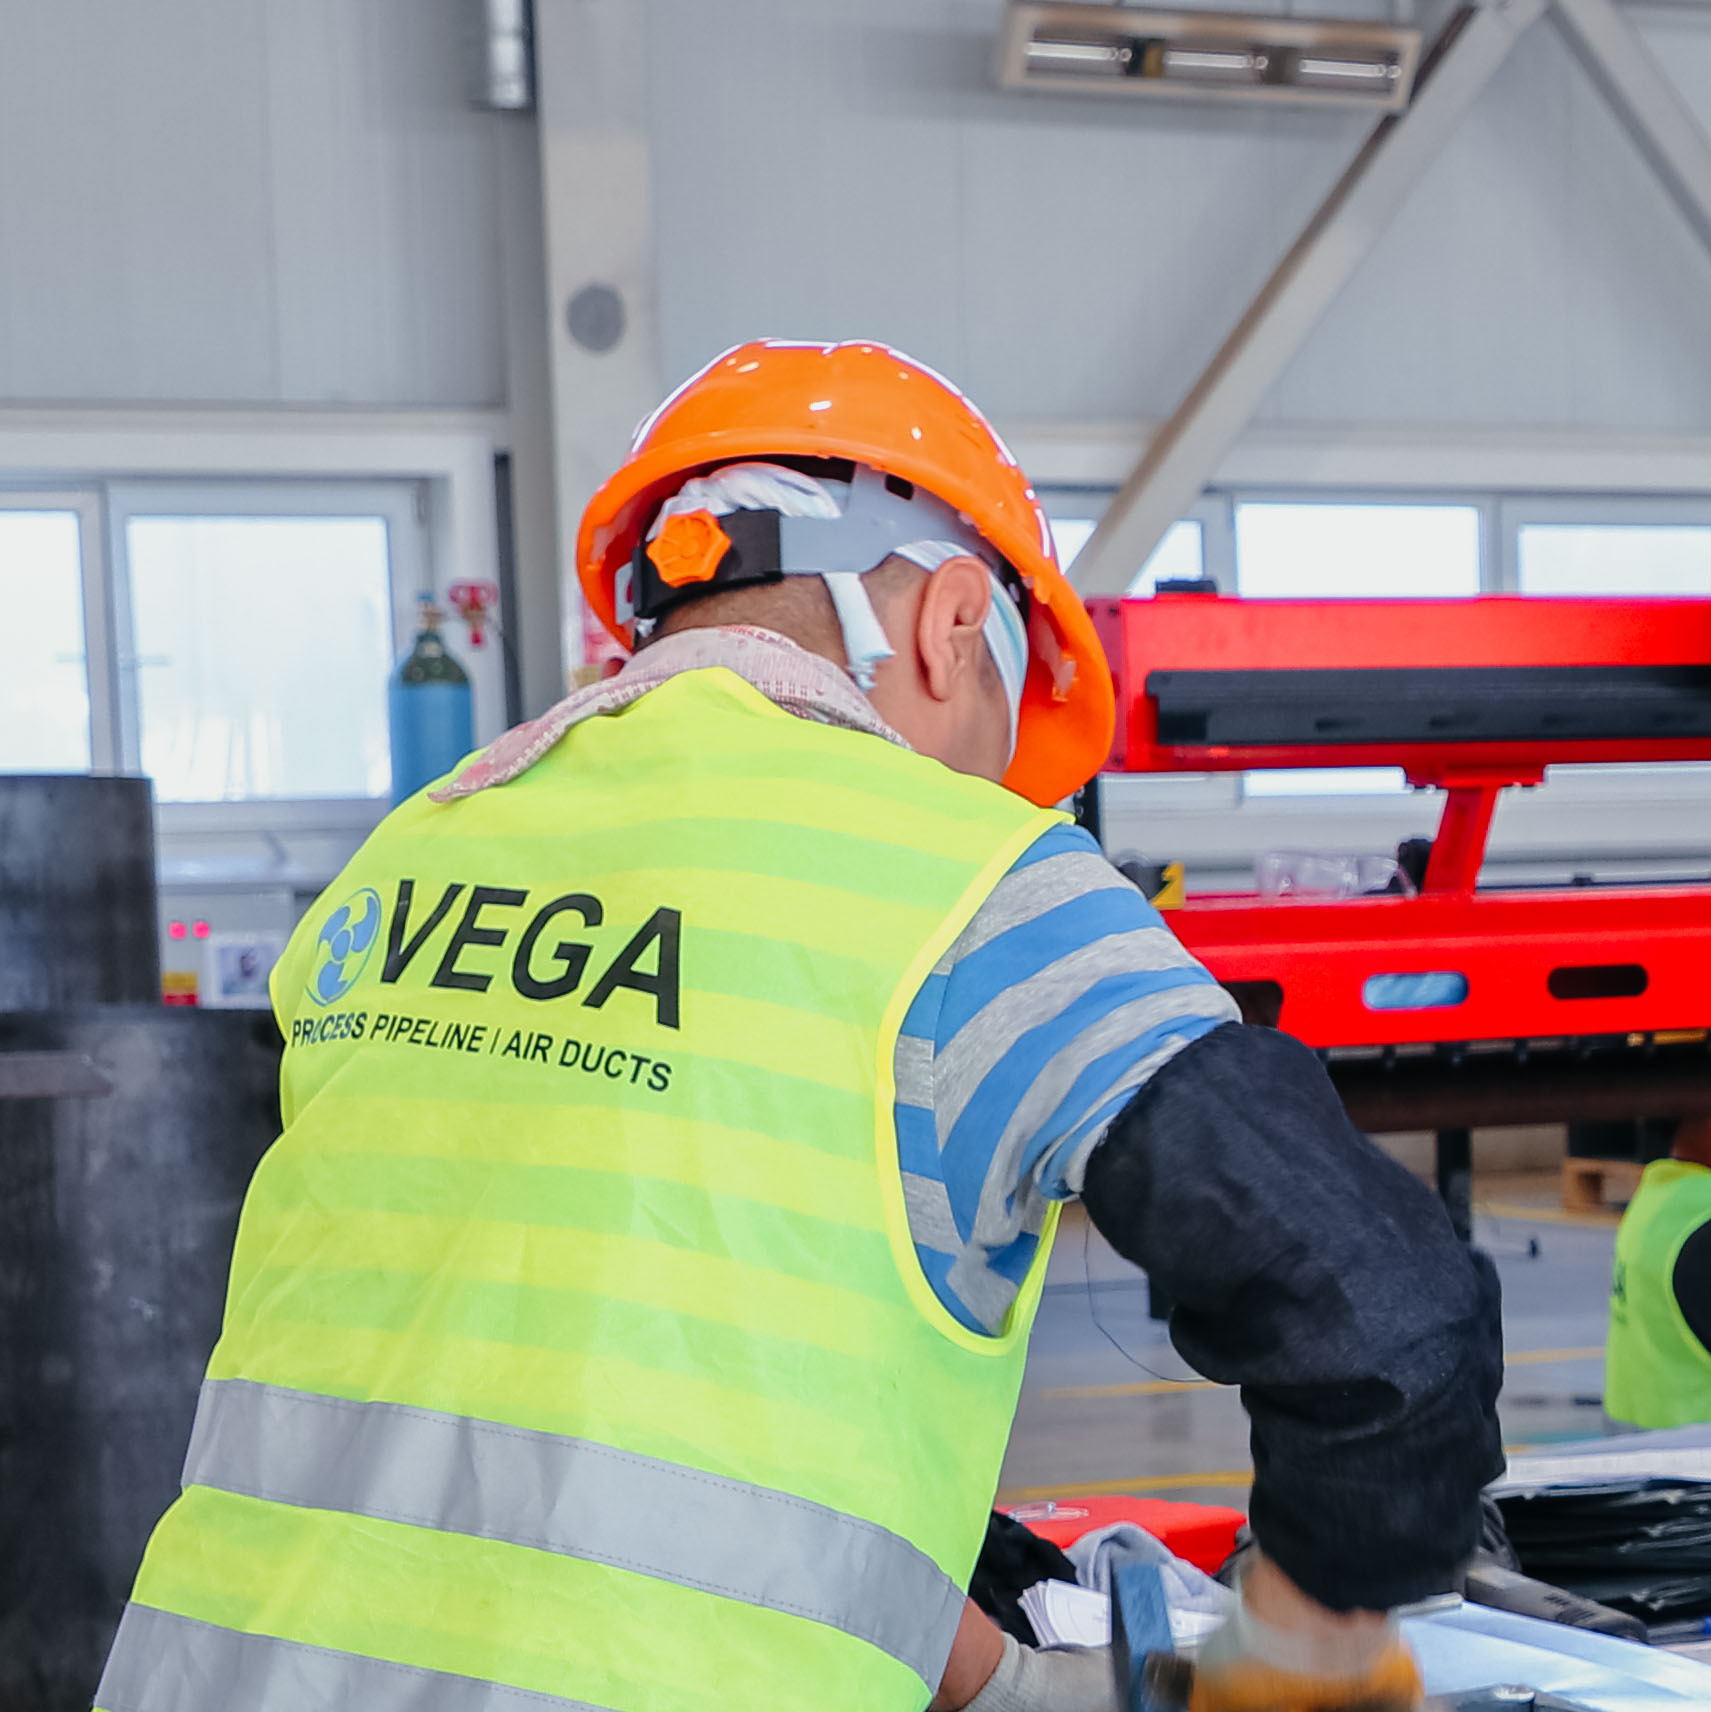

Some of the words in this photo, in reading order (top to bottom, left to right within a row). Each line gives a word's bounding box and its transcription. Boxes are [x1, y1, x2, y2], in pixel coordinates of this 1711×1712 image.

[380, 878, 682, 1030] VEGA
[291, 1011, 367, 1048] PROCESS
[369, 1015, 485, 1055] PIPELINE
[502, 1031, 551, 1063] AIR
[558, 1040, 672, 1092] DUCTS
